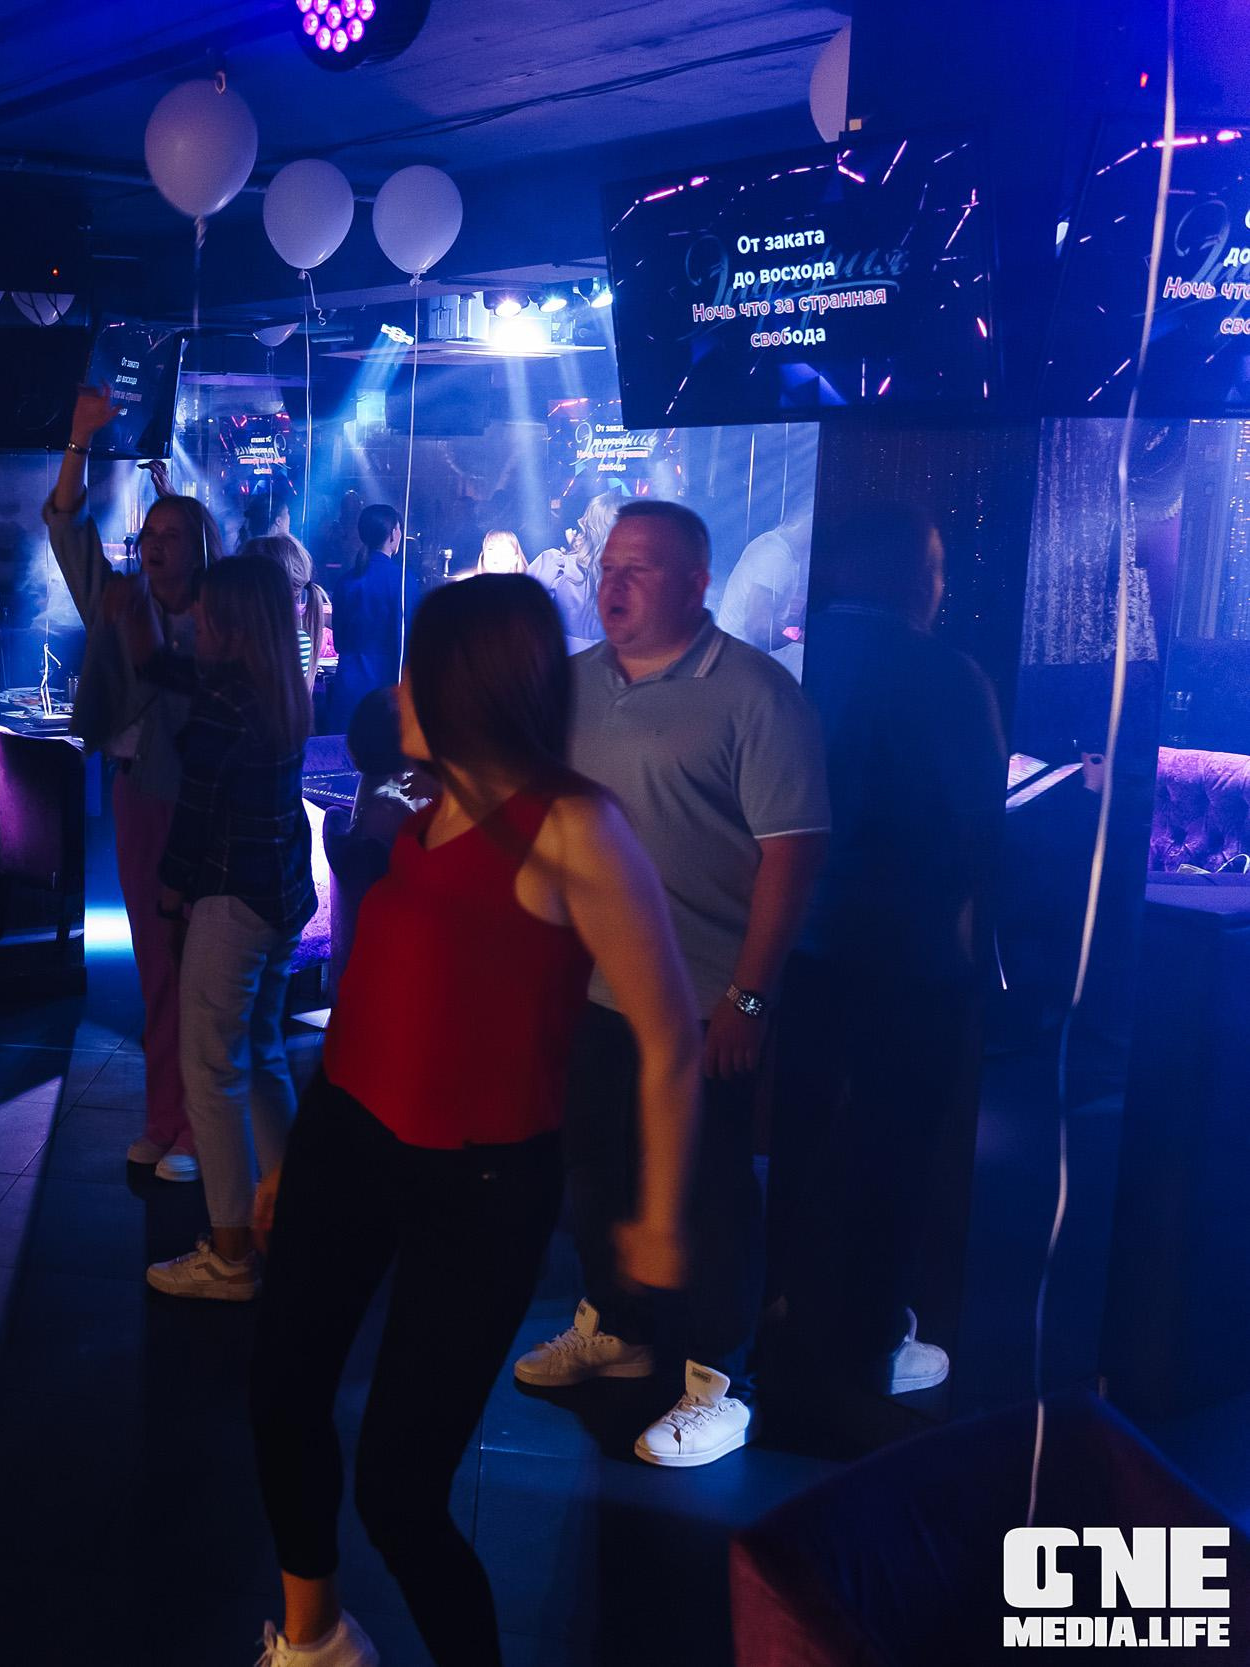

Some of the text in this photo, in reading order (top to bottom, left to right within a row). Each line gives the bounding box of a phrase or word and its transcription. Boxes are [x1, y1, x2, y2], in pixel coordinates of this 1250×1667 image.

[737, 229, 825, 254] От заката
[732, 261, 835, 289] до восхода
[1162, 276, 1216, 299] Ночь
[692, 288, 887, 323] Ночь что за странная
[750, 326, 826, 348] свобода
